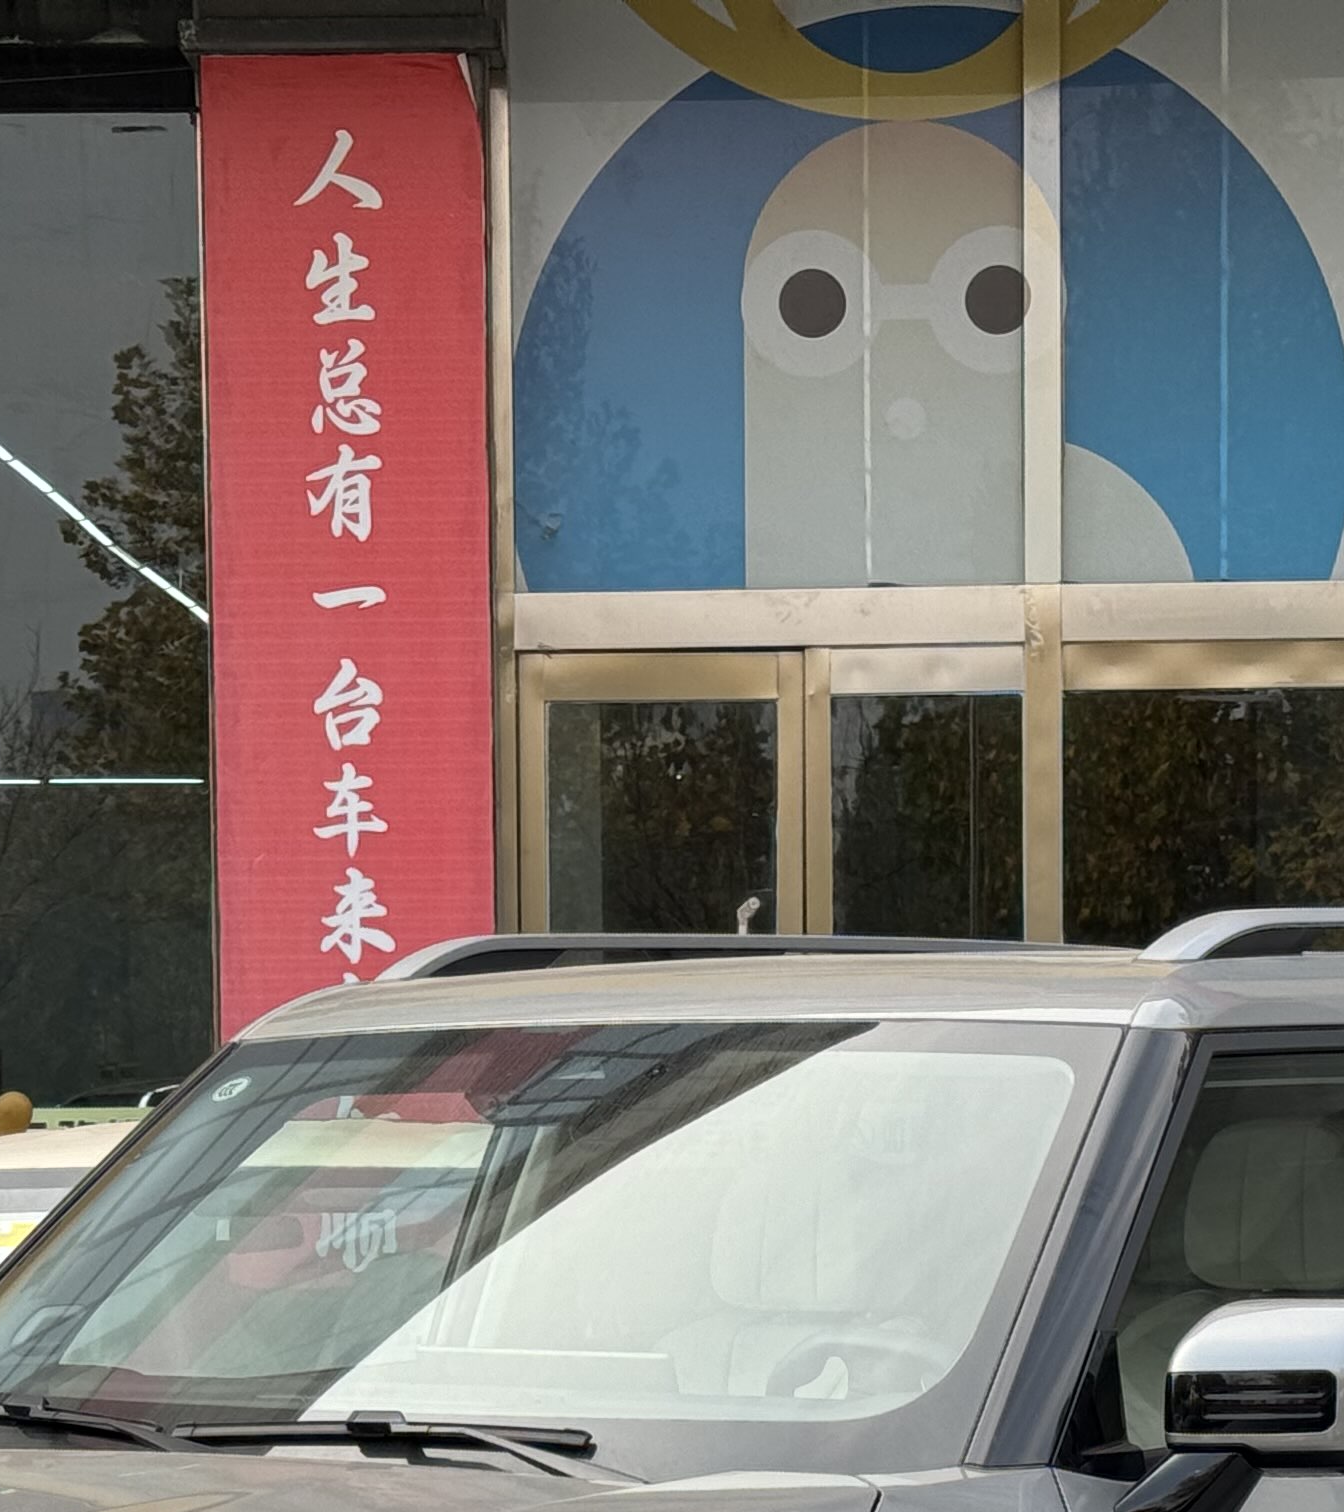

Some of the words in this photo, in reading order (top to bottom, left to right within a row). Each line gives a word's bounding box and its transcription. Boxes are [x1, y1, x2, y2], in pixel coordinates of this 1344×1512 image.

[294, 130, 397, 985] 人生总有一台车来
